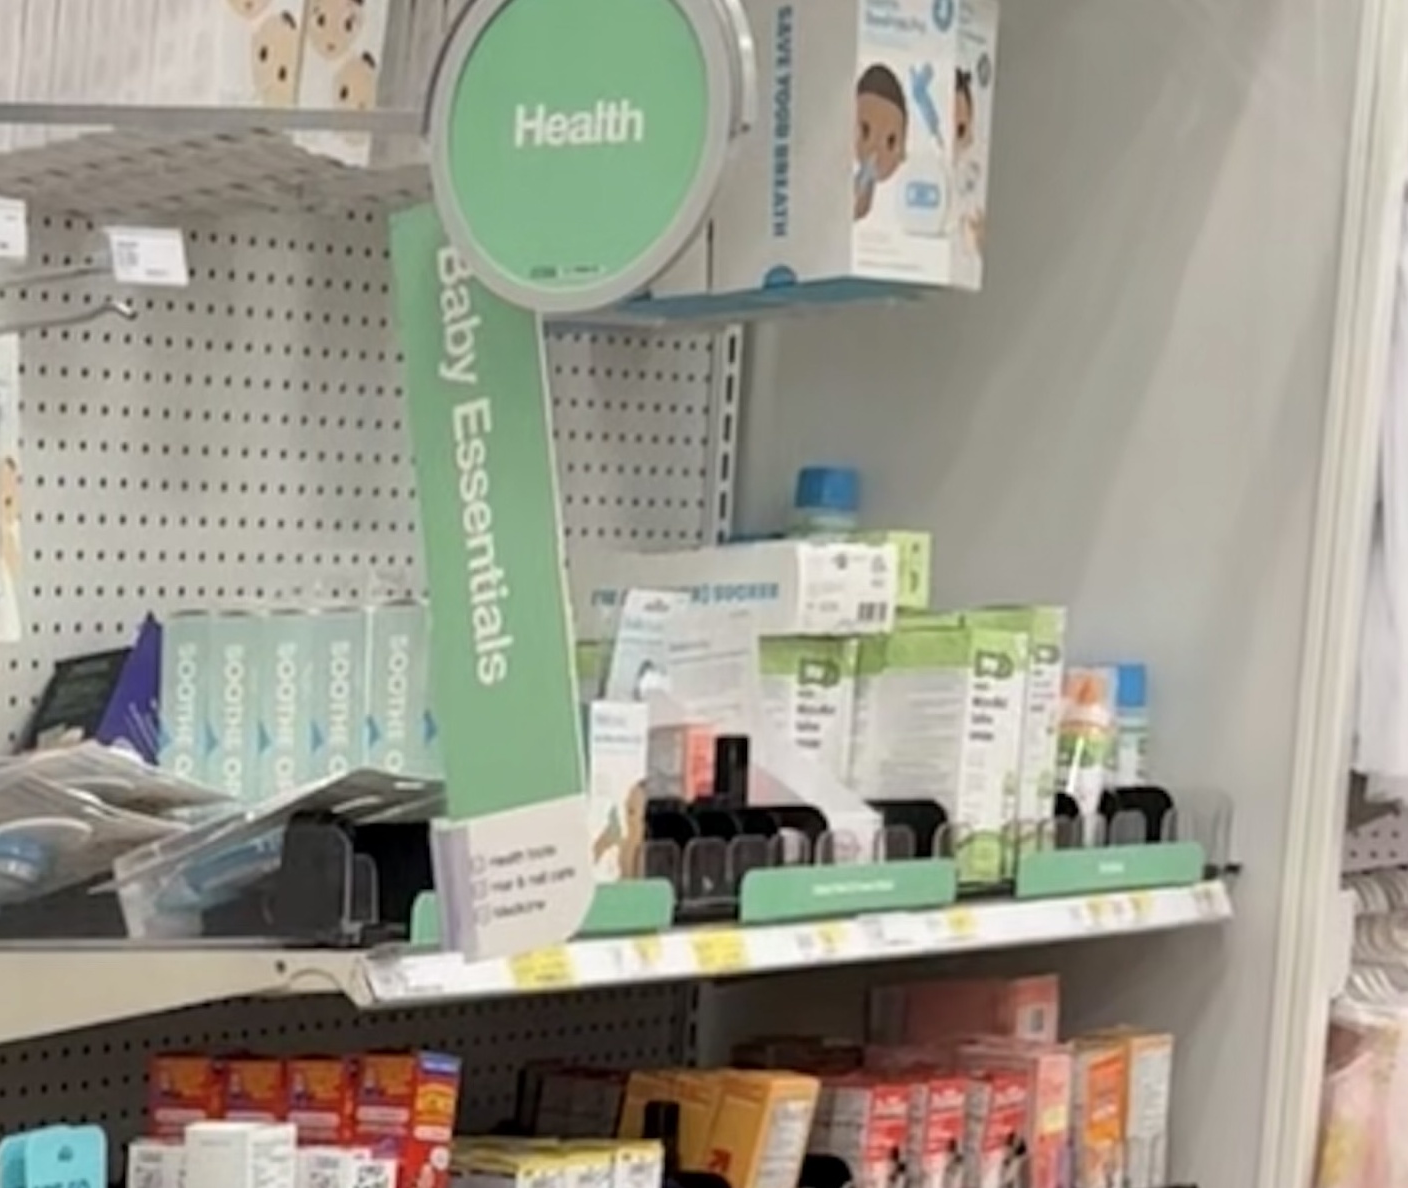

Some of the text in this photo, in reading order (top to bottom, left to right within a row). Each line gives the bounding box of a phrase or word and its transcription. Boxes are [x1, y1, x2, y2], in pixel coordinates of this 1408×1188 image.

[514, 99, 644, 148] Health
[772, 144, 790, 237] BREATH
[438, 247, 514, 686] Baby Essentials
